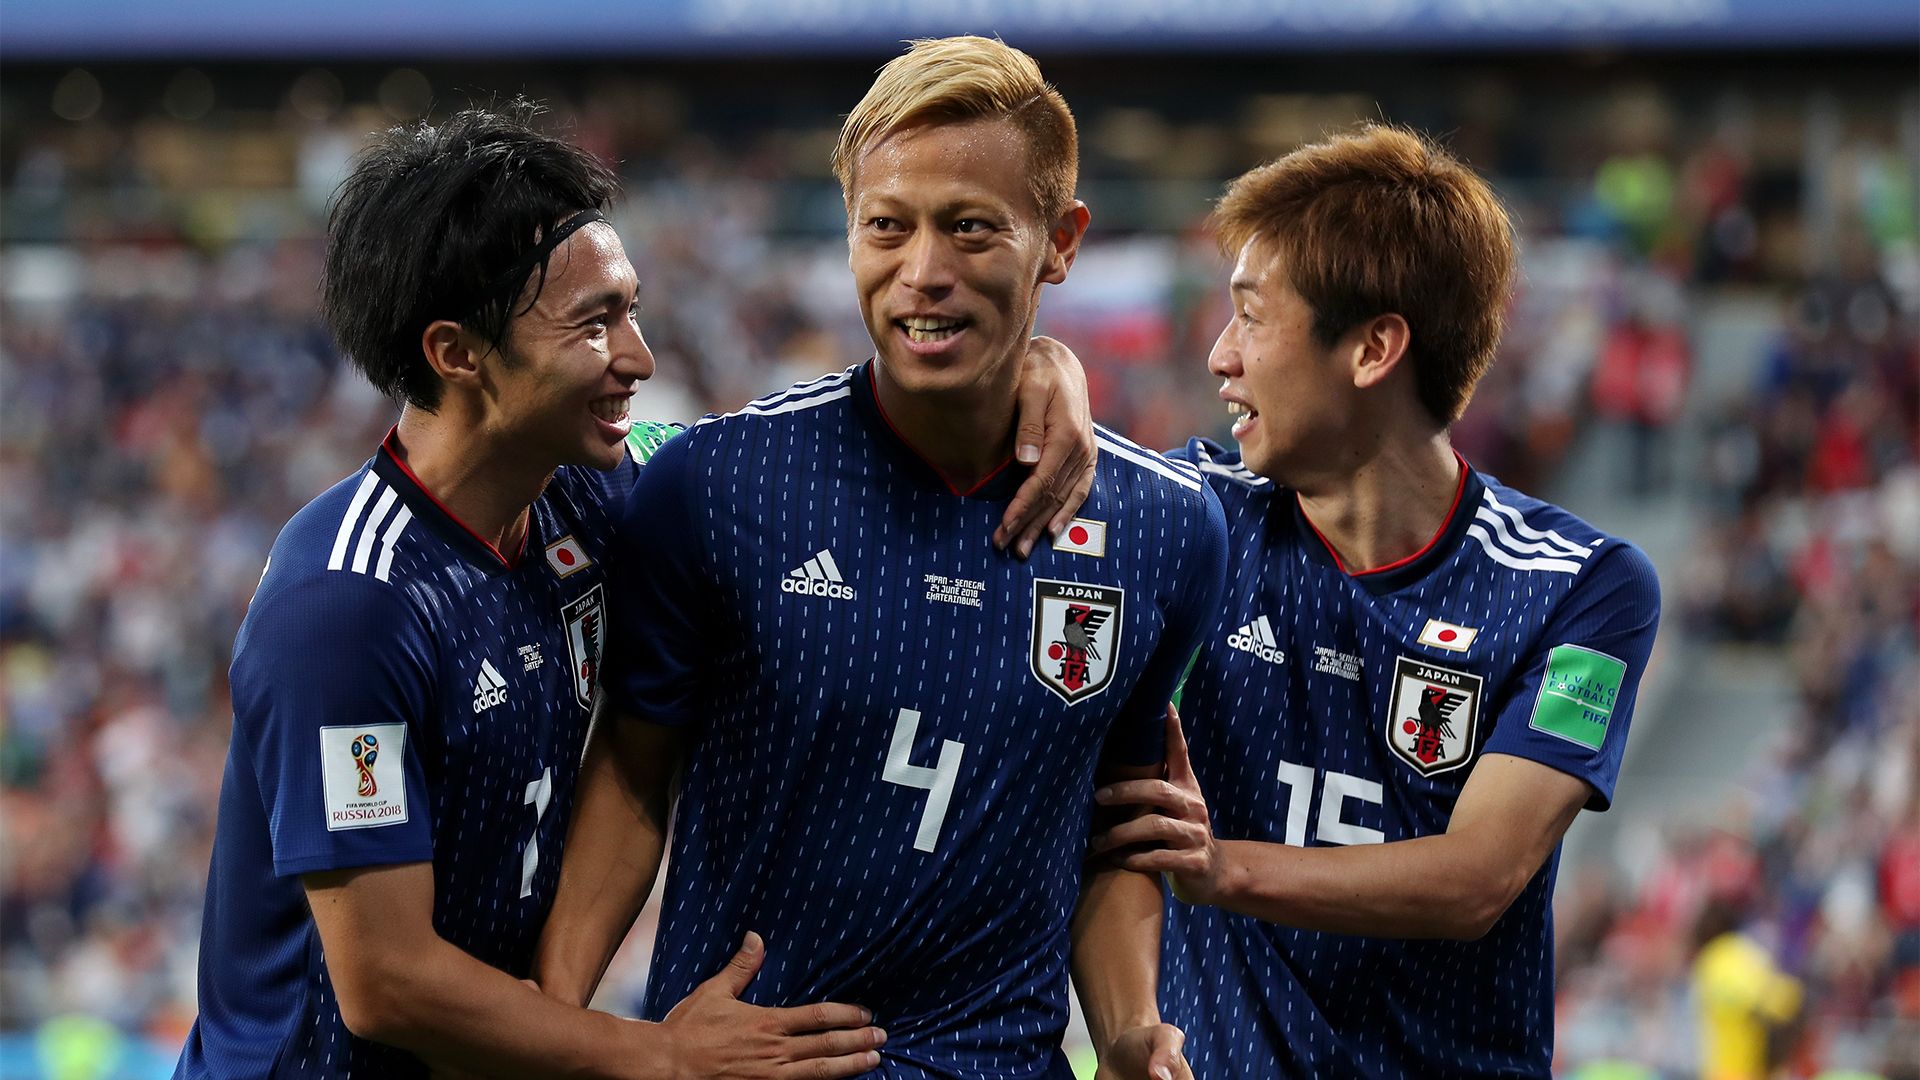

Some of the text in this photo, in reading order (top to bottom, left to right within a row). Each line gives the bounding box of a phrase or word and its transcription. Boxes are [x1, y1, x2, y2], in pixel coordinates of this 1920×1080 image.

[781, 577, 854, 600] adidas
[924, 574, 948, 585] JAPAN
[954, 578, 986, 591] SENEGAL
[930, 583, 979, 598] 24 JUNE 2018
[926, 591, 981, 607] EKATERINBURG
[1057, 586, 1103, 600] JAPAN
[1227, 633, 1285, 664] adidas
[1054, 662, 1091, 684] JFA
[1416, 667, 1460, 685] JAPAN
[1551, 671, 1616, 697] LIVING
[1582, 710, 1608, 726] FIFA
[1407, 737, 1447, 760] JFA
[881, 707, 966, 853] 4
[332, 805, 402, 822] RUSSIA 2018
[1277, 759, 1385, 848] 15
